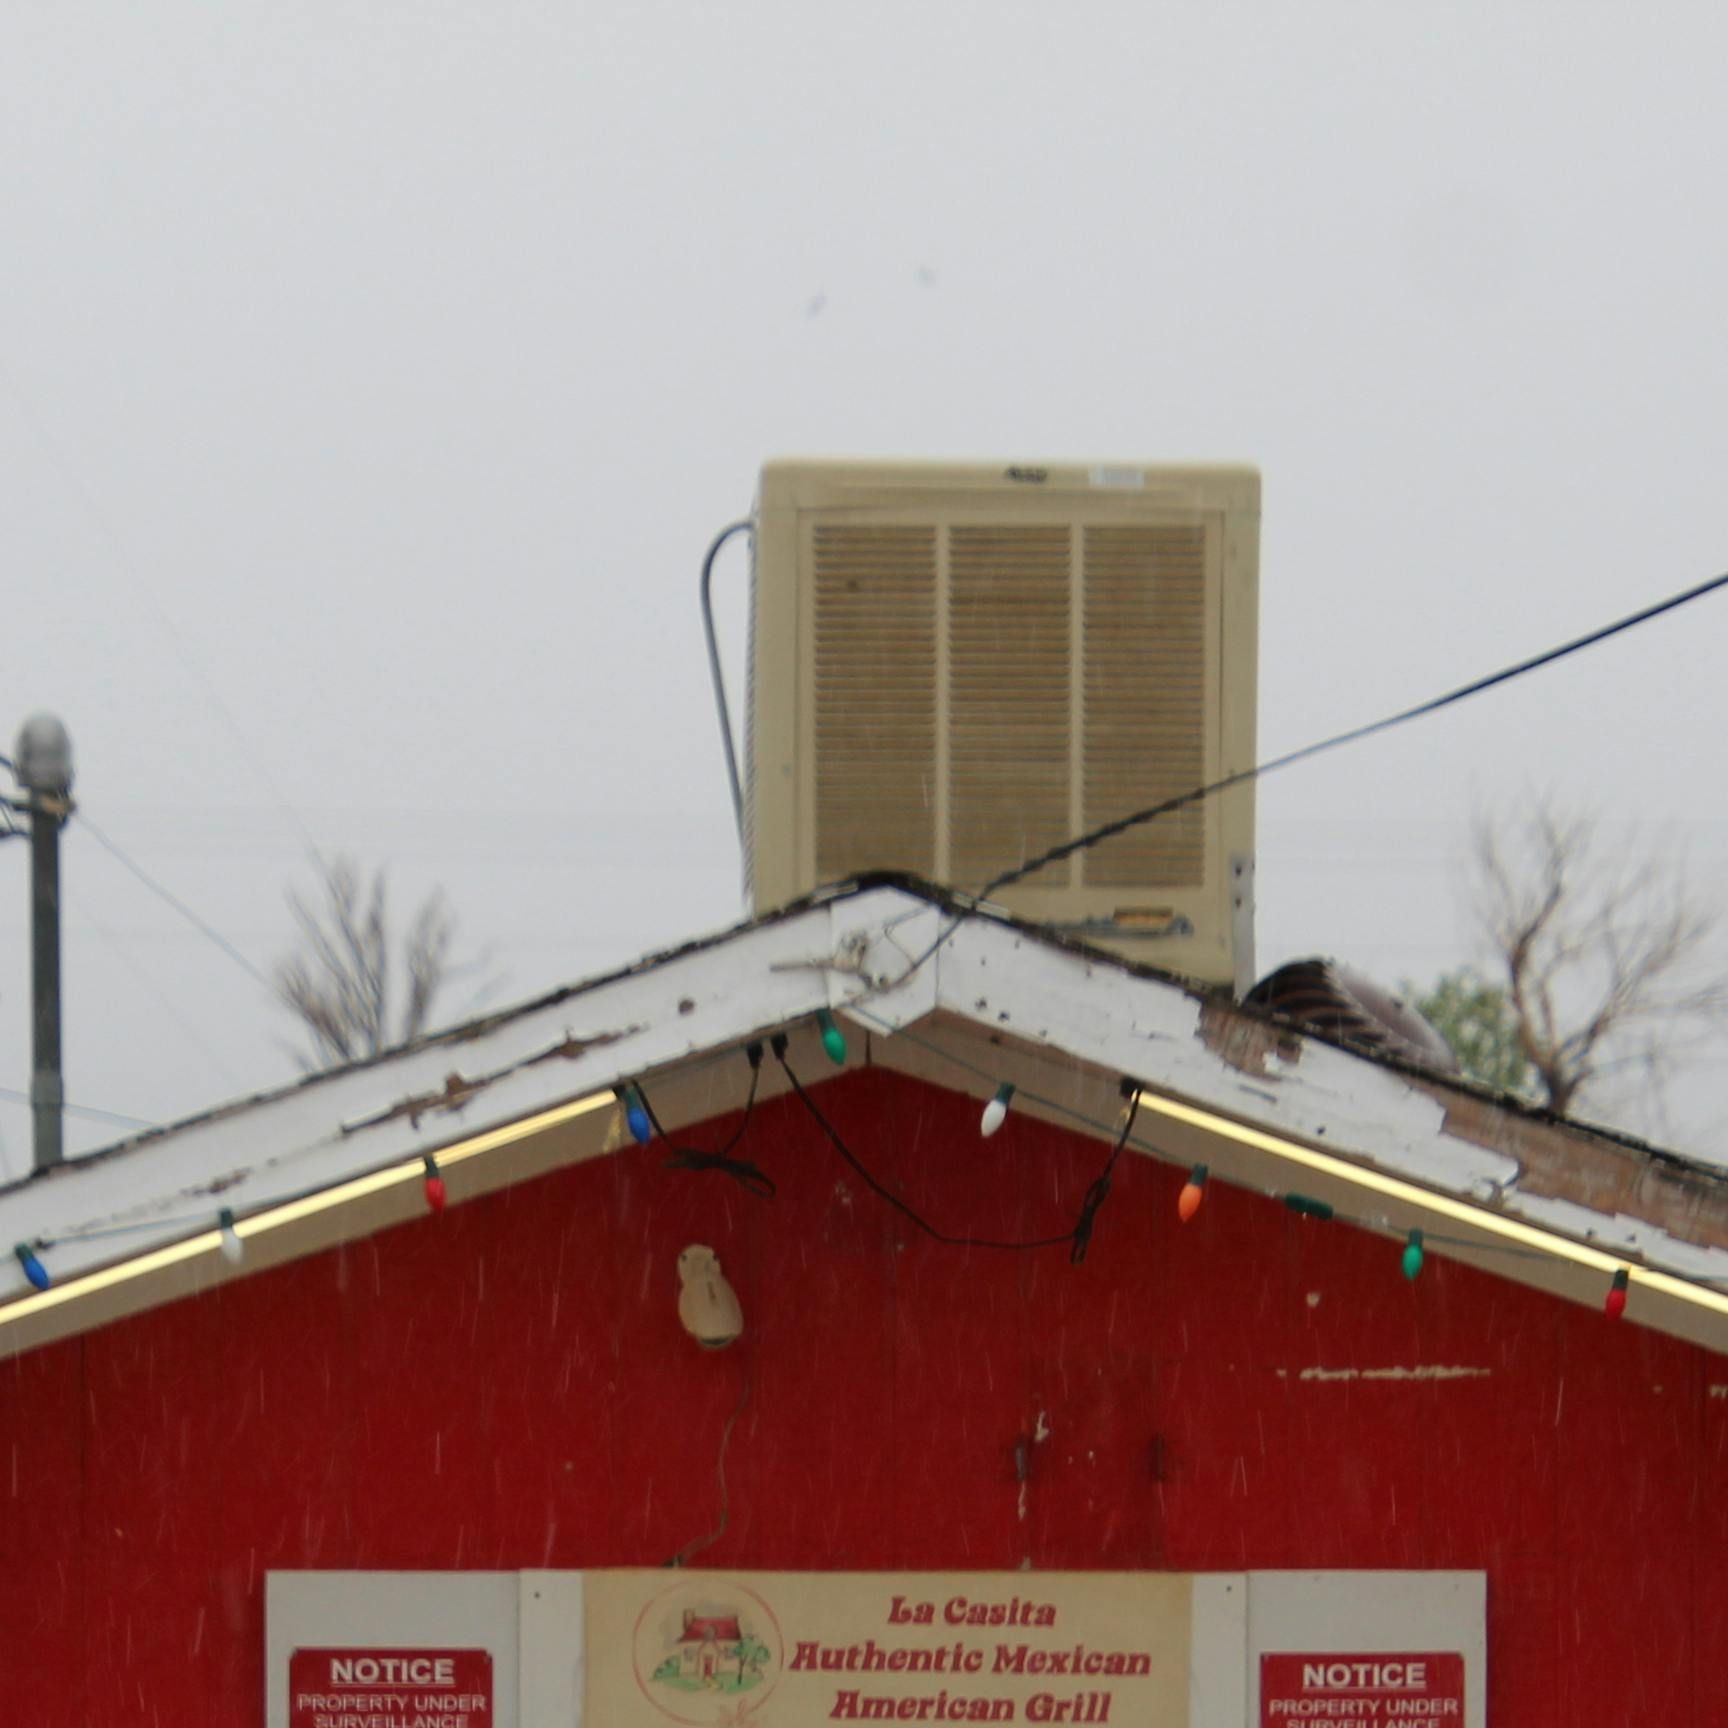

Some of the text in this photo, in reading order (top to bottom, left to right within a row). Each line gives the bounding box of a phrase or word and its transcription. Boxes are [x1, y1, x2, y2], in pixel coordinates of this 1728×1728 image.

[887, 1596, 1057, 1628] La Casita
[330, 1658, 455, 1684] NOTICE
[789, 1641, 1152, 1676] Authentic Mexican
[1302, 1663, 1426, 1688] NOTICE
[298, 1694, 486, 1712] PROPERTY UNDER
[829, 1690, 1112, 1724] American Grill
[1269, 1699, 1458, 1716] PROPERTY UNDER
